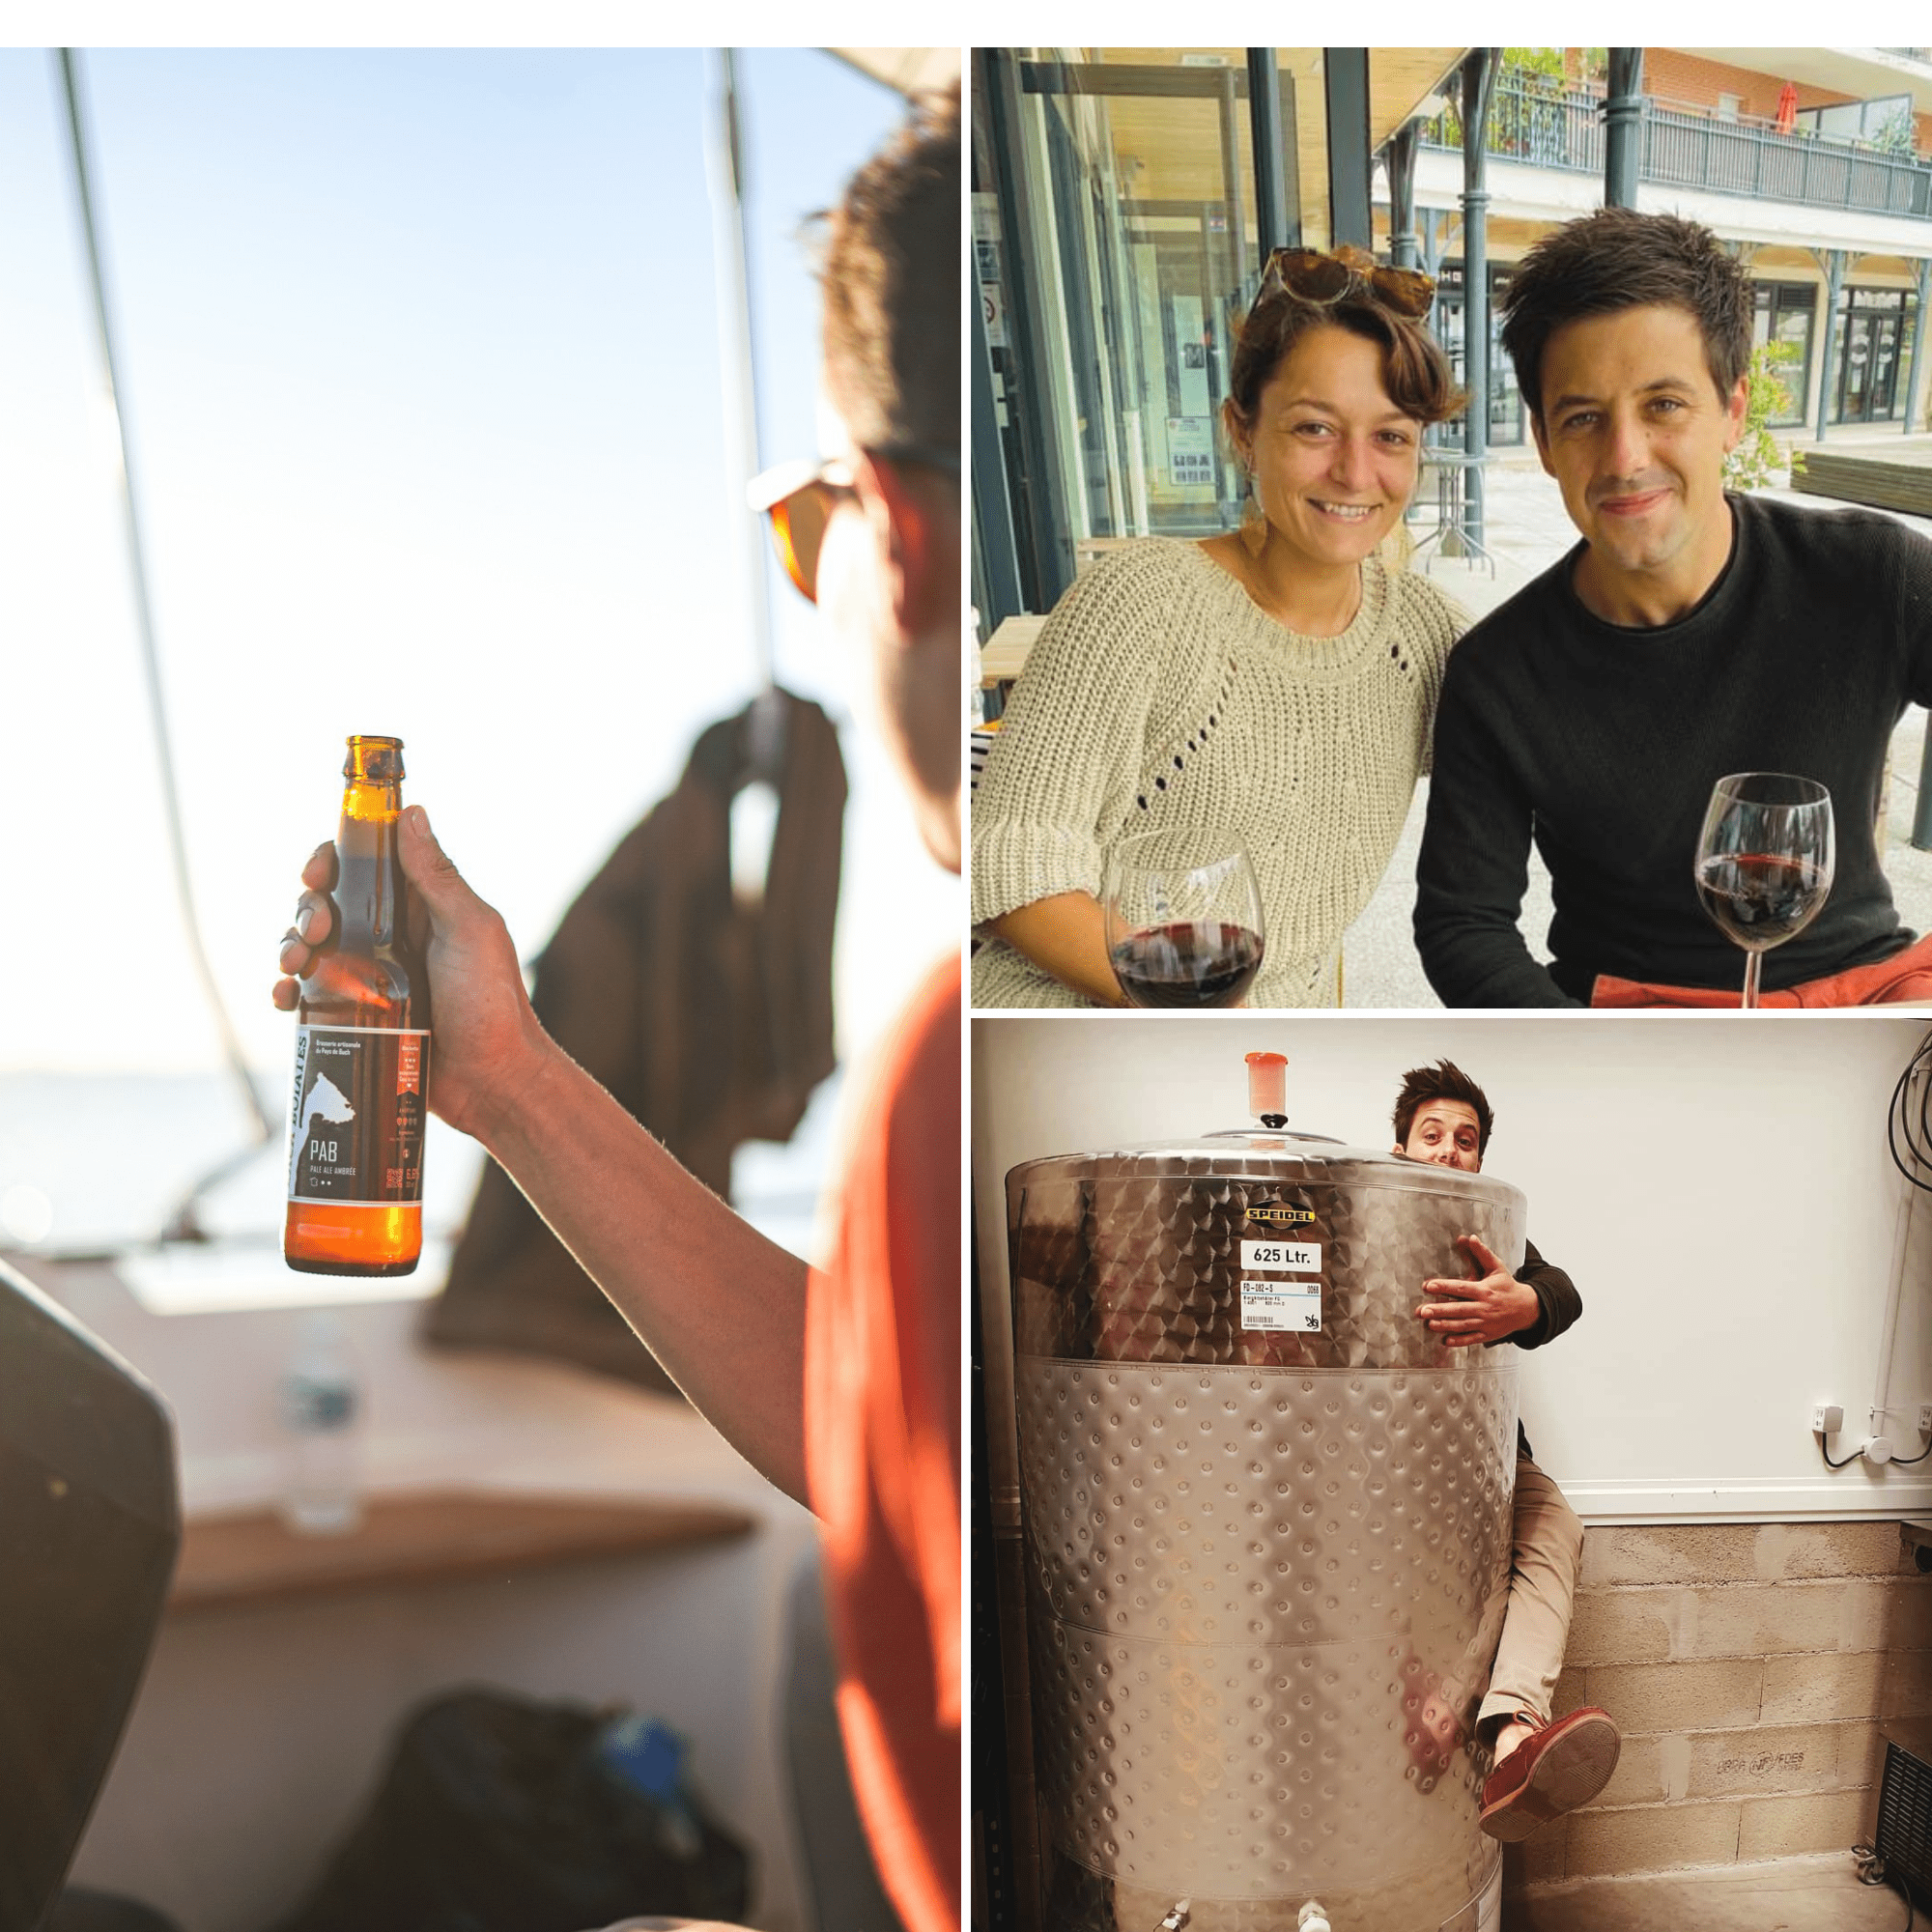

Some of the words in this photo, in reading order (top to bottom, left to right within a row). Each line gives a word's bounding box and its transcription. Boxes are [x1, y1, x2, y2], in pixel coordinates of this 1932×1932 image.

[310, 1140, 338, 1162] PAB
[310, 1165, 322, 1174] PALE
[324, 1166, 333, 1175] ALE
[1248, 1209, 1314, 1221] SPEIDEL
[1254, 1248, 1281, 1263] 625
[1286, 1249, 1311, 1264] Ltr.
